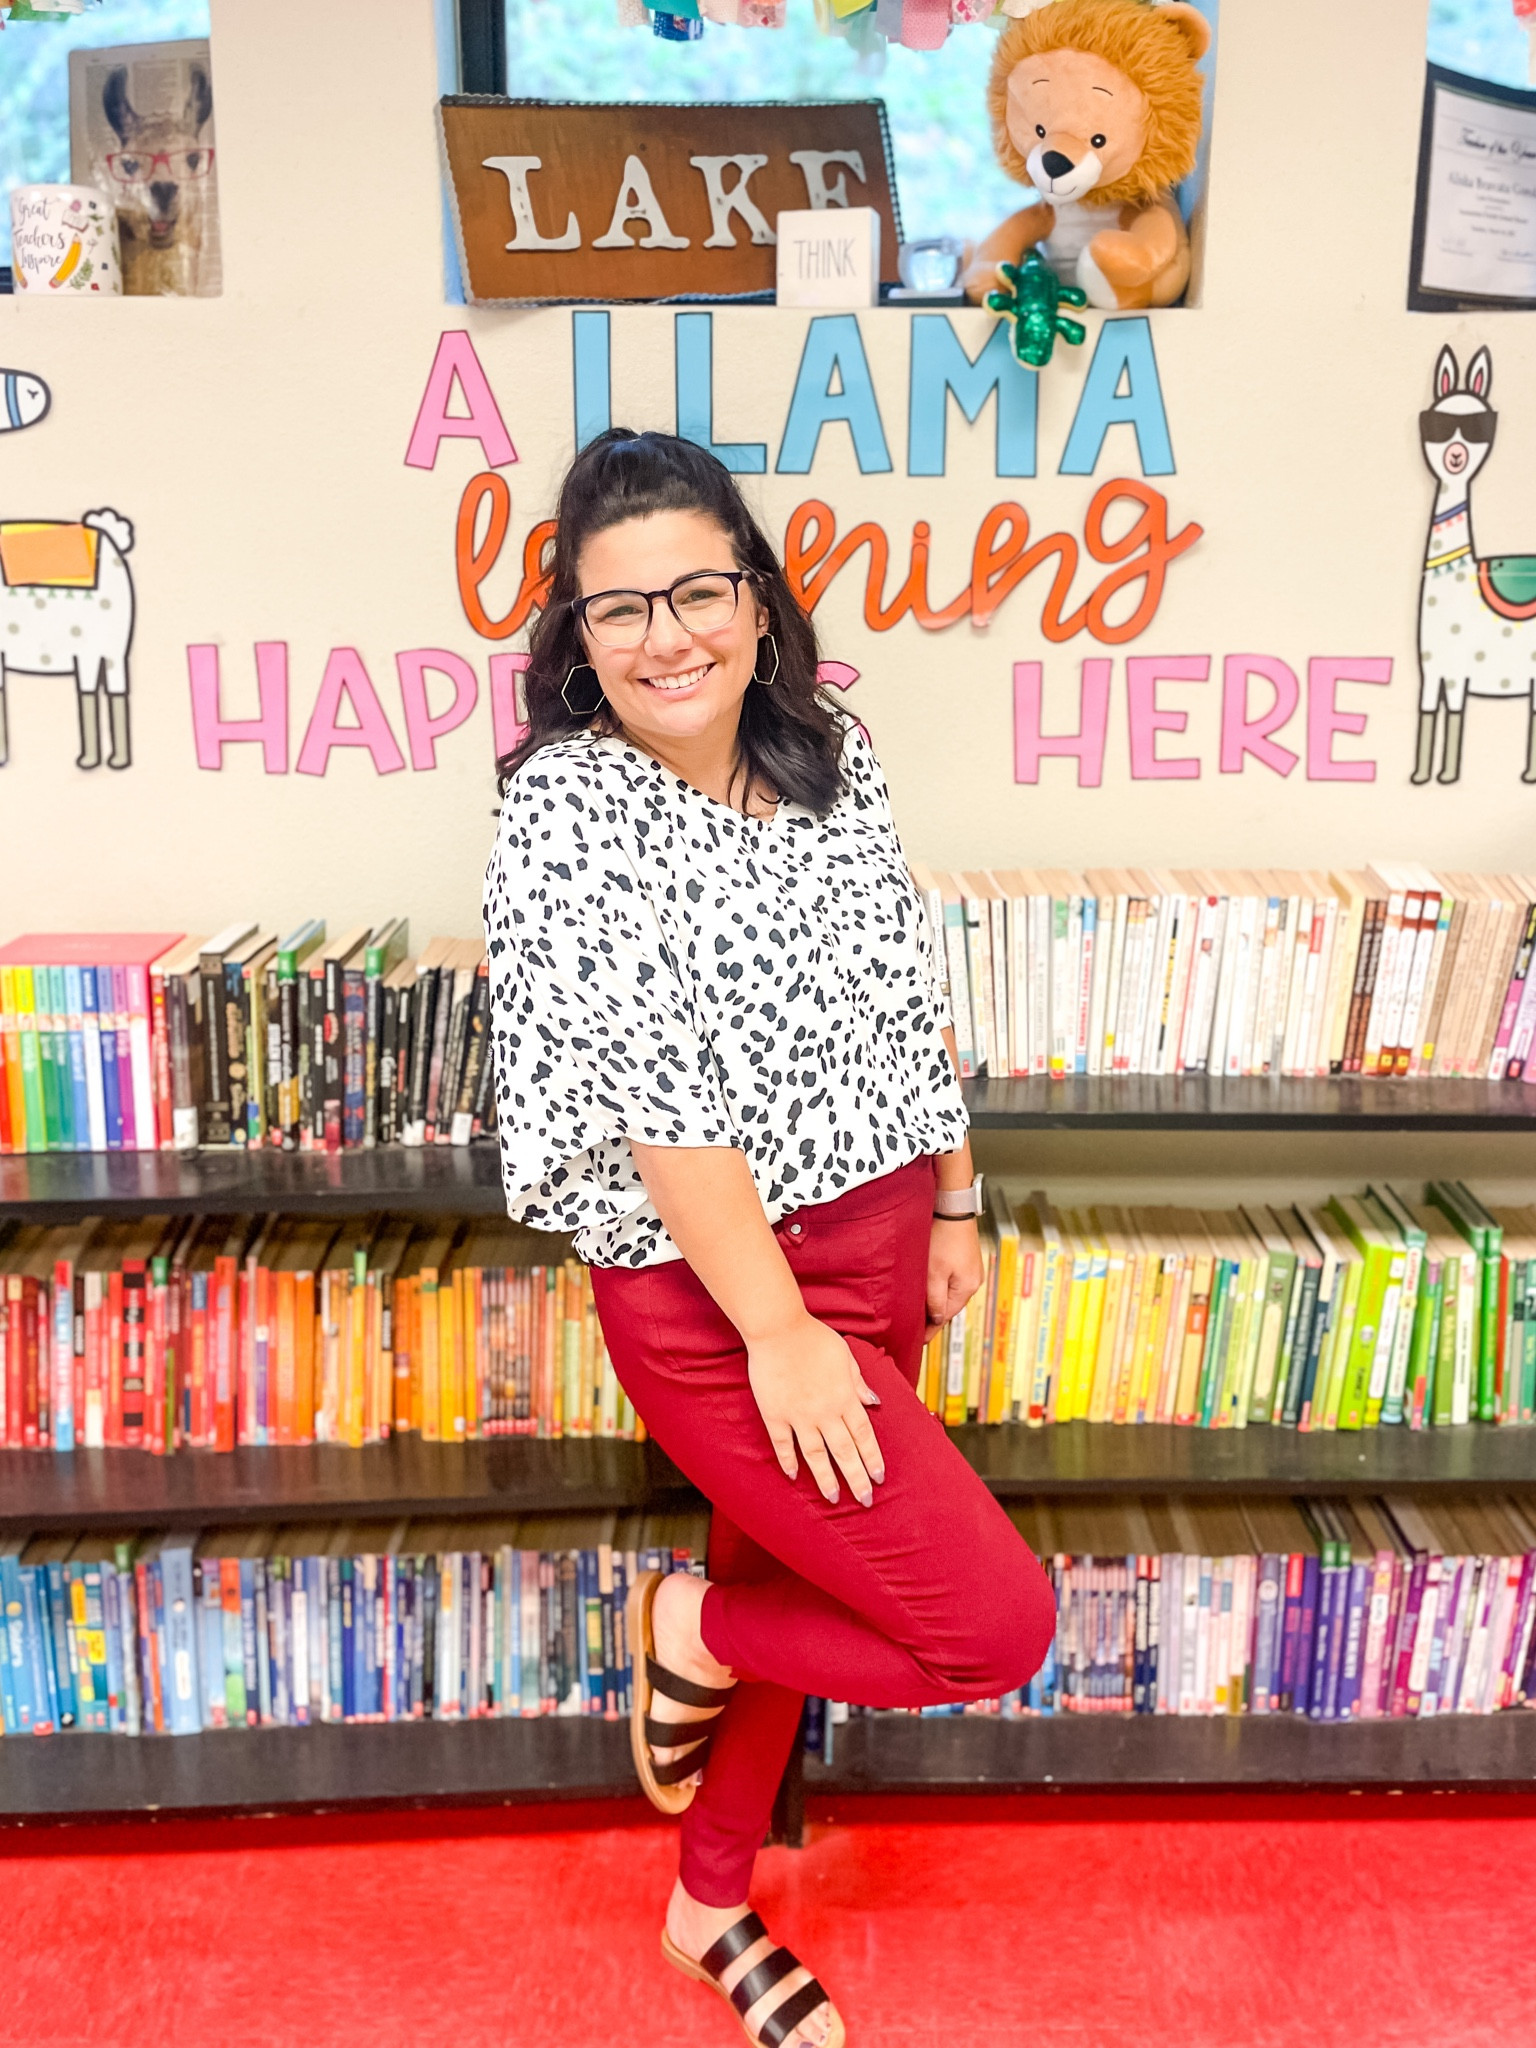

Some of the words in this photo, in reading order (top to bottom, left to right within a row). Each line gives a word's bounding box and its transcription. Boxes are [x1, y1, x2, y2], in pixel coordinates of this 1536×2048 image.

[793, 237, 857, 280] THINK
[404, 329, 519, 471] A
[1012, 653, 1394, 788] HERE
